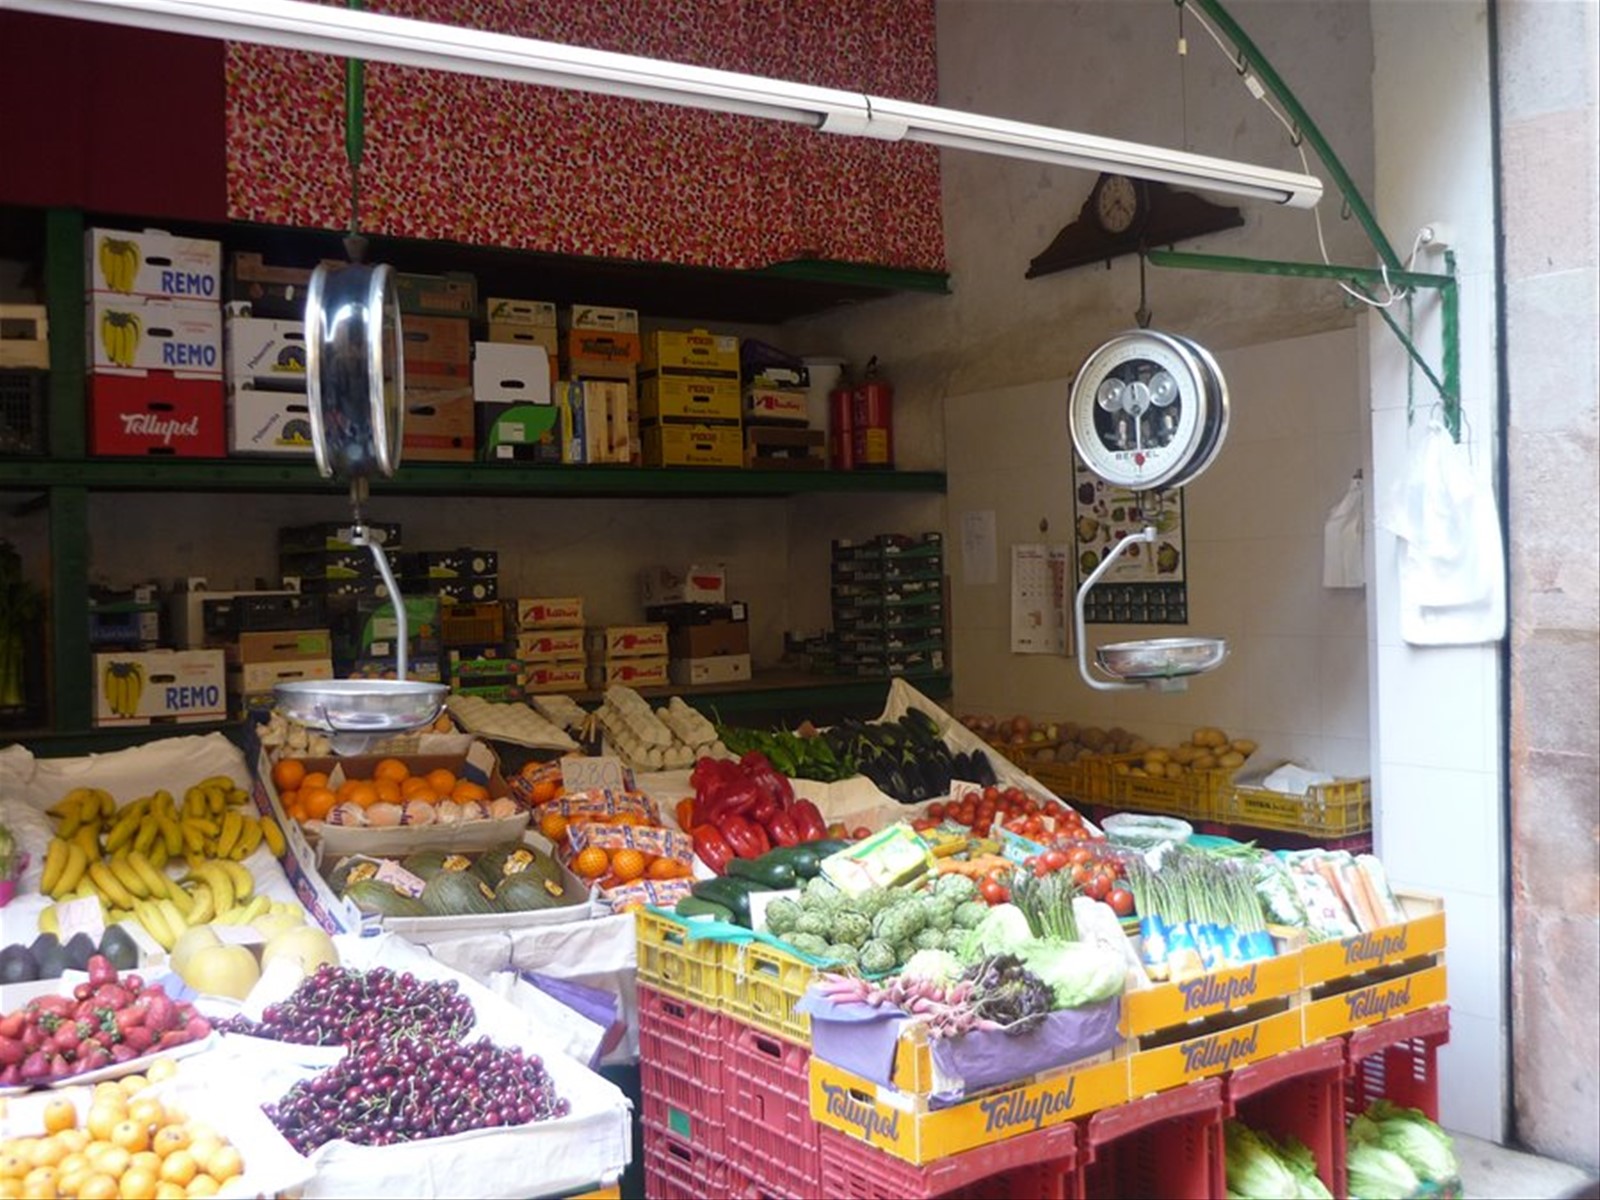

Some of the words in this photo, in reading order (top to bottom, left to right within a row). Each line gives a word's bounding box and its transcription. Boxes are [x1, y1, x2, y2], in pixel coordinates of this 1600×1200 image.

[162, 271, 214, 296] REMO
[163, 342, 216, 367] REMO
[120, 413, 199, 445] Tollupol
[166, 685, 219, 711] REMO
[1342, 931, 1407, 974] Tollupol
[1179, 963, 1257, 1012] Tollupol
[1346, 977, 1411, 1022] Tollupol
[1180, 1025, 1258, 1075] Tollupol
[821, 1077, 900, 1143] Tollupol
[980, 1076, 1075, 1132] Tollupol
